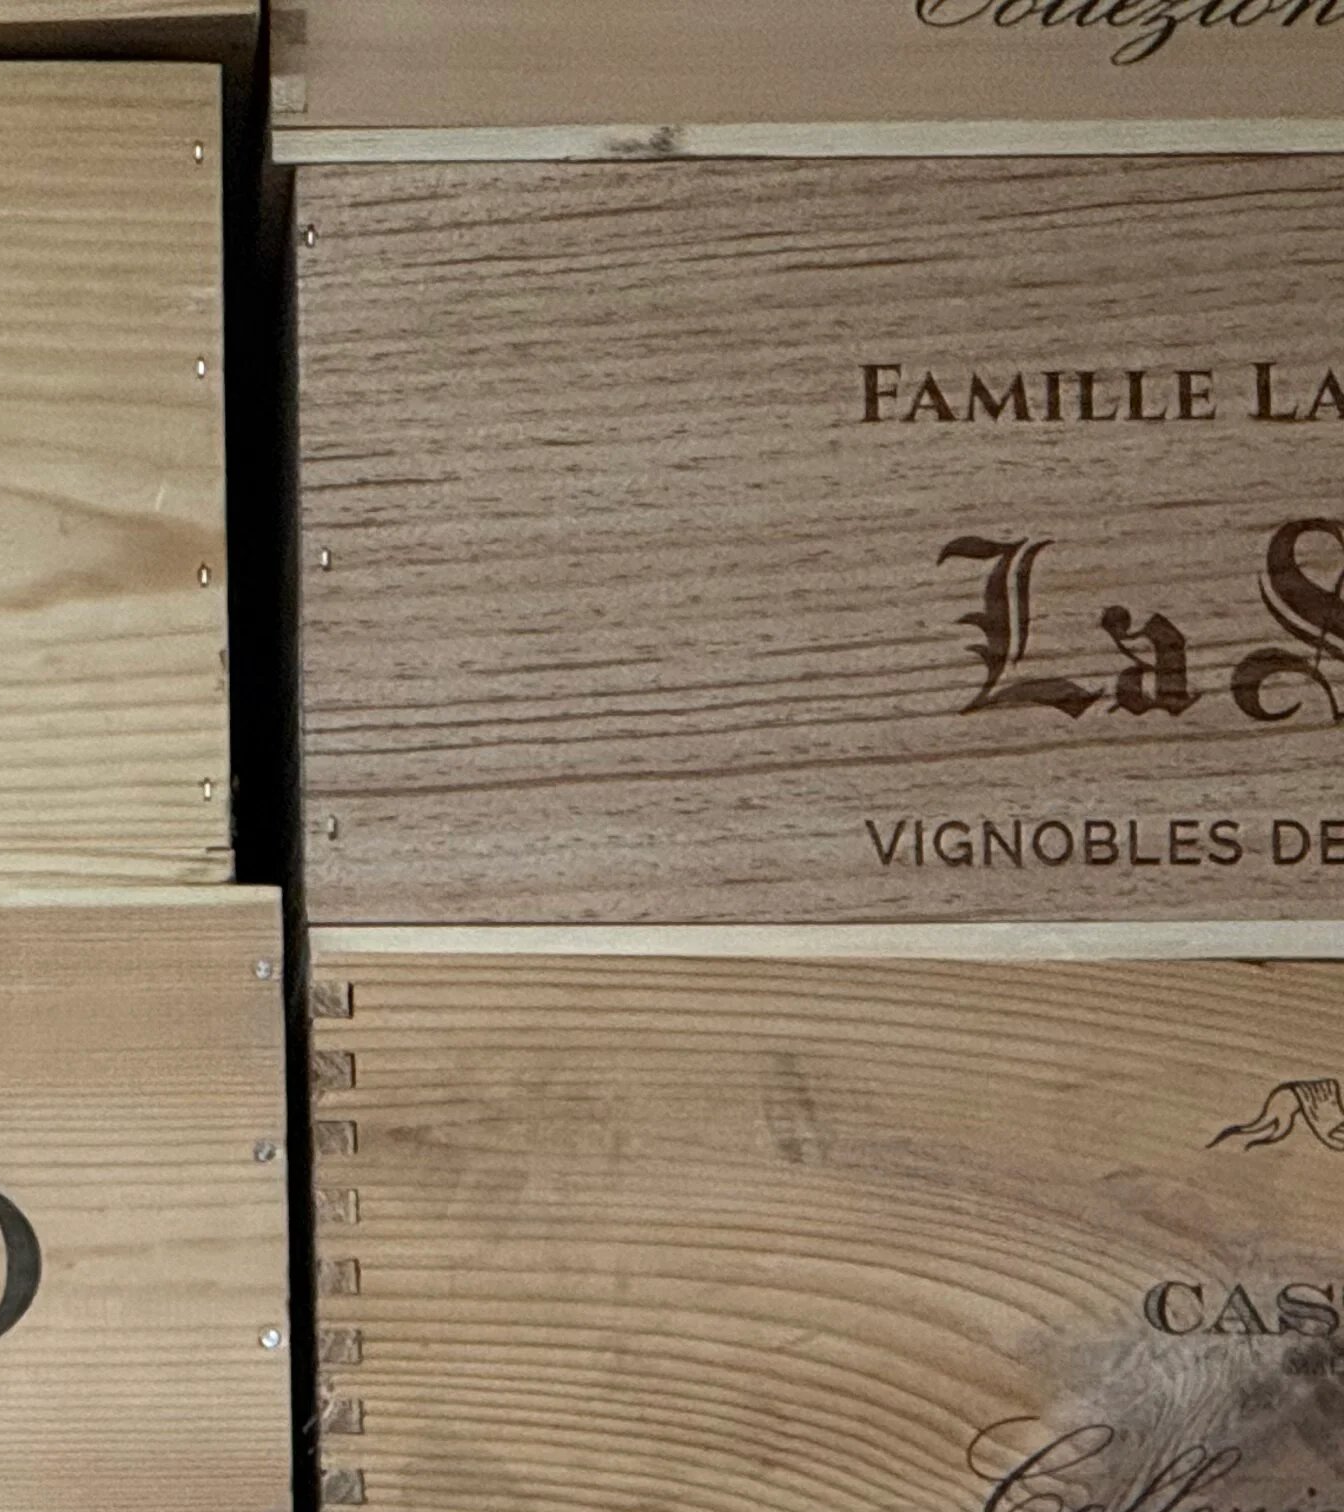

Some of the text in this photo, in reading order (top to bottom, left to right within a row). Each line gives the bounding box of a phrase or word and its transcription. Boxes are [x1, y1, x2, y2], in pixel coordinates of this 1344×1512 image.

[858, 362, 1218, 423] FAMILLE
[864, 818, 1344, 868] VIGNOBLES DE
